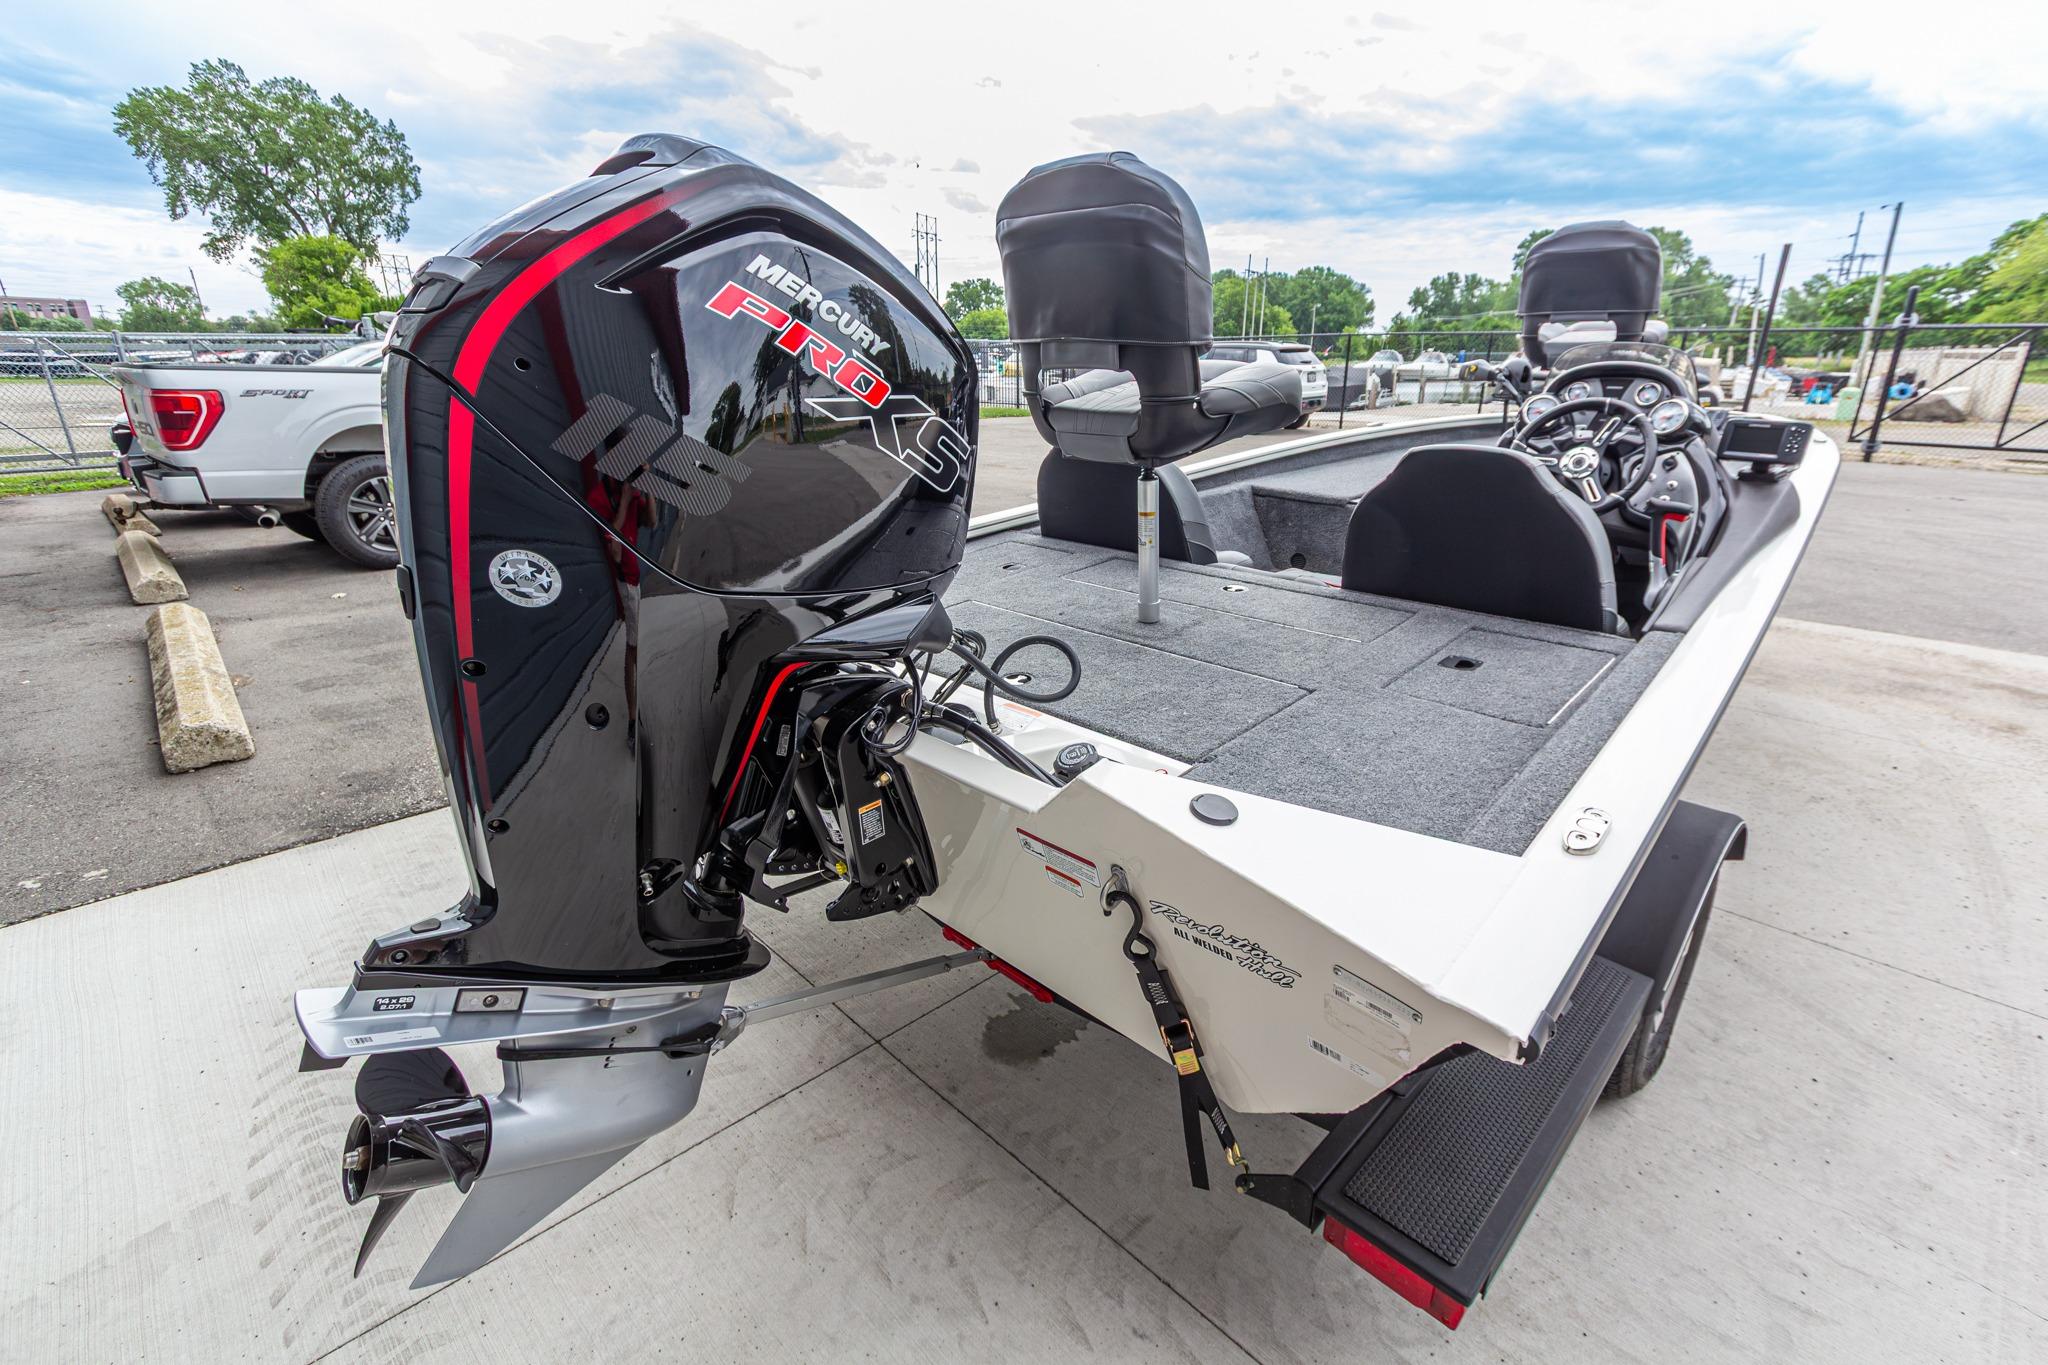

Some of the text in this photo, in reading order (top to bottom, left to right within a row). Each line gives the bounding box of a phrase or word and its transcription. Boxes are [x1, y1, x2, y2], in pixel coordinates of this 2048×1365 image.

[705, 280, 892, 409] PRO
[745, 254, 891, 356] MERCURY
[239, 389, 315, 399] SPORT
[550, 392, 752, 517] 115
[537, 557, 556, 574] LOW
[1149, 899, 1302, 978] Revolution
[1173, 926, 1295, 989] ALL WELDED Hull
